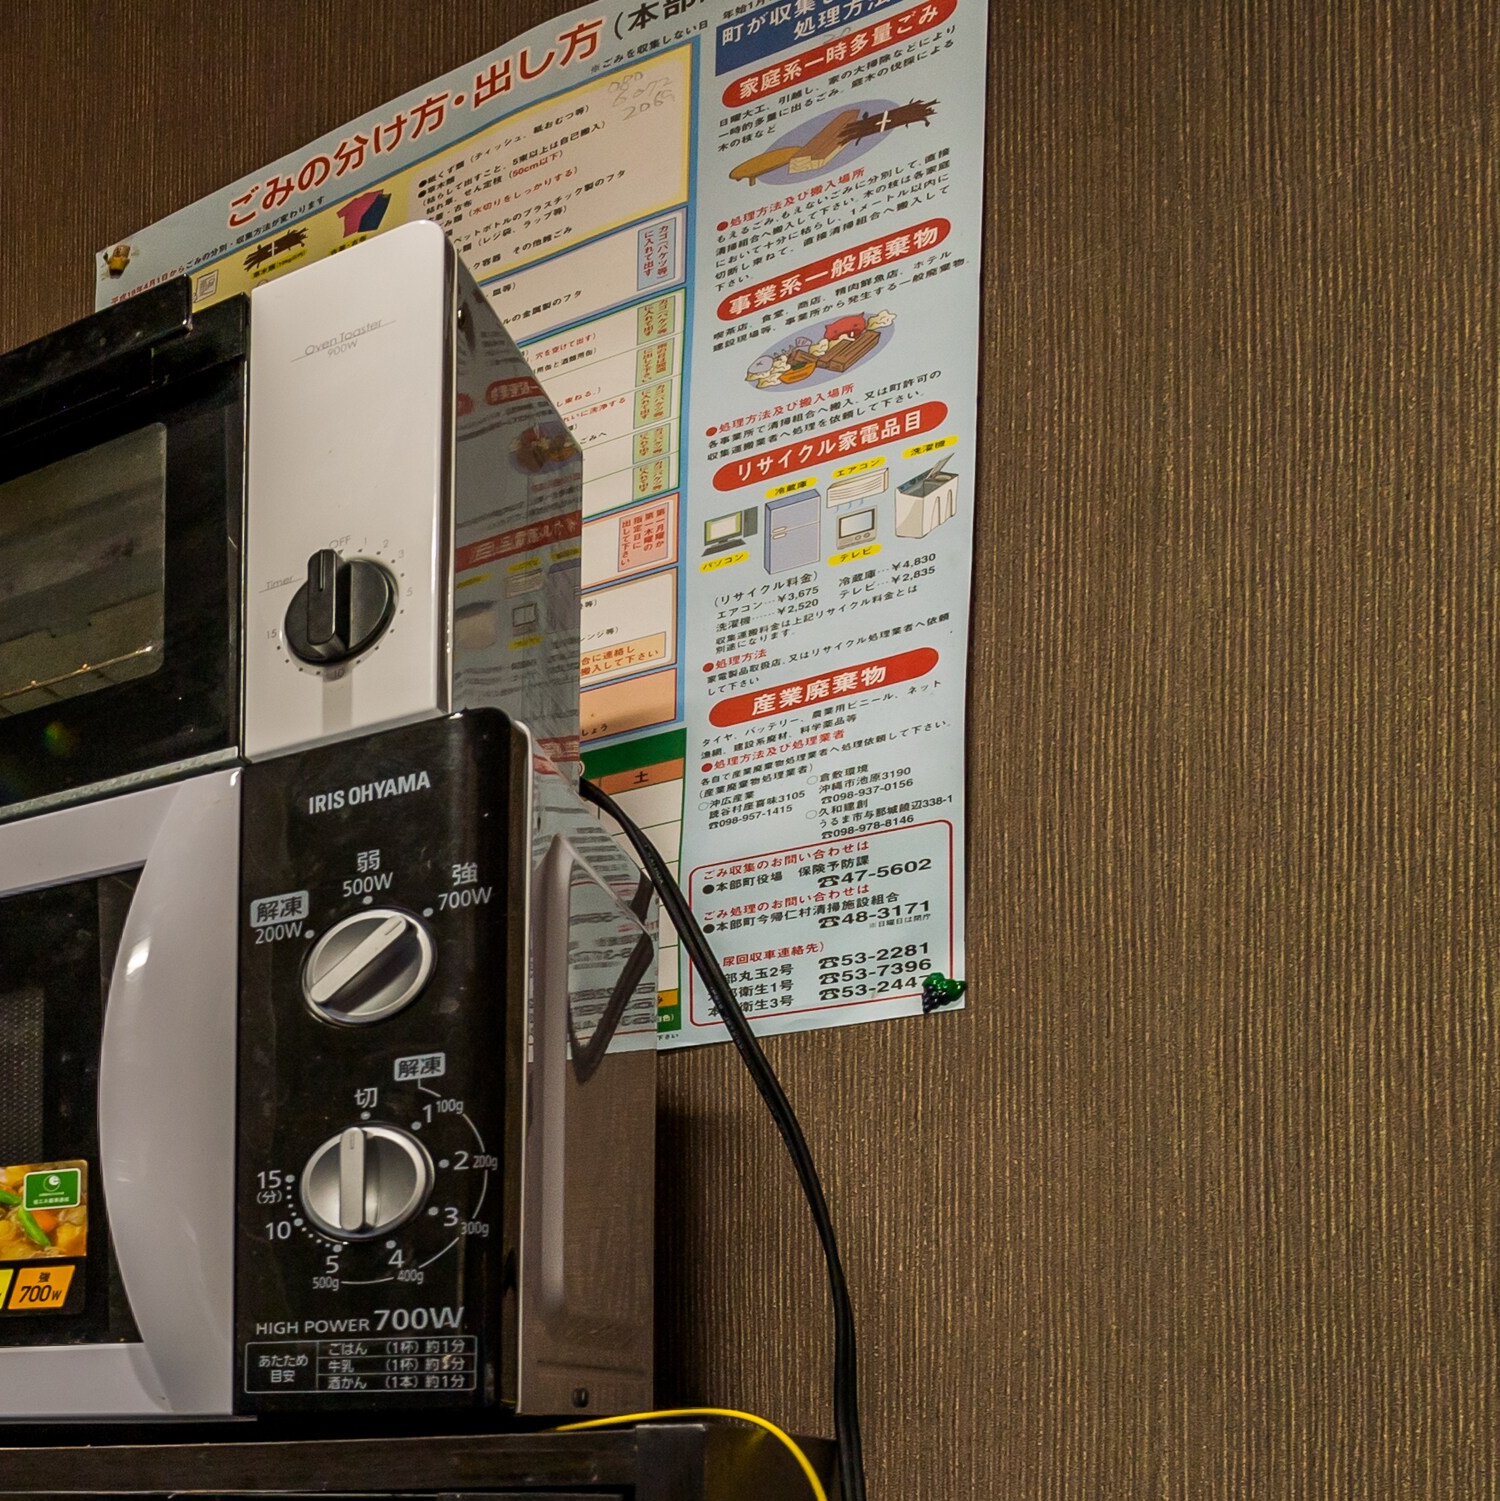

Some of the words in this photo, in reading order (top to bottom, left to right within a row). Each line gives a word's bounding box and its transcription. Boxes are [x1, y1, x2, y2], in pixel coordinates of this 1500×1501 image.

[738, 3, 940, 99] 家庭系一時多量ごみ
[229, 17, 603, 228] ごみの分け方・出し方
[614, 0, 704, 41] （本部
[729, 228, 938, 315] 事業系一般廃棄物
[304, 336, 338, 356] Oven
[339, 319, 384, 343] Toaster
[328, 339, 358, 357] 900W
[738, 409, 921, 480] リサイクル家電品目
[910, 438, 946, 457] 洗濯機
[835, 459, 881, 478] エアコン
[774, 479, 808, 496] 冷蔵庫
[329, 536, 351, 549] OFF
[383, 539, 389, 548] 2
[701, 553, 745, 571] パソコン
[839, 547, 873, 563] テレビ
[265, 576, 294, 590] Timer
[406, 587, 413, 597] 5
[266, 629, 278, 639] 15
[715, 648, 767, 670] 処理方法
[333, 668, 345, 679] 10
[752, 665, 886, 716] 産業廃棄物
[633, 771, 649, 785] 土
[309, 789, 344, 815] IRIS
[348, 771, 431, 806] OHYAMA
[356, 849, 381, 873] 弱
[704, 841, 870, 880] ごみ収集のお問い合わせは
[452, 862, 478, 886] 強
[841, 858, 932, 884] 47-5602
[342, 872, 393, 897] 500W
[438, 886, 493, 911] 700W
[704, 884, 870, 921] ごみ処理のお問い合わせは
[256, 895, 303, 923] 解凍
[842, 900, 931, 925] 48-3171
[255, 921, 303, 944] 200W
[718, 942, 825, 968] 尿回収車連絡先）
[842, 942, 930, 967] 53-2281
[842, 959, 932, 983] 53-7396
[397, 1056, 442, 1078] 解凍
[354, 1087, 378, 1108] 切
[422, 1104, 433, 1123] 1
[436, 1099, 464, 1114] 100g
[453, 1151, 469, 1171] 2
[473, 1155, 498, 1171] 200g
[256, 1170, 281, 1190] 15
[265, 1221, 291, 1240] 10
[443, 1207, 459, 1227] 3
[461, 1221, 489, 1237] 300g
[325, 1255, 340, 1274] 5
[388, 1249, 405, 1268] 4
[37, 1271, 51, 1284] 強
[312, 1276, 340, 1291] 500g
[397, 1268, 424, 1285] 400g
[256, 1321, 299, 1335] HIGH
[304, 1319, 370, 1333] POWER
[373, 1306, 465, 1331] 700W
[328, 1343, 368, 1357] ごはん
[258, 1354, 308, 1368] あたため
[327, 1359, 355, 1373] 牛乳
[270, 1369, 295, 1383] 目安
[327, 1376, 367, 1390] 酒かん
